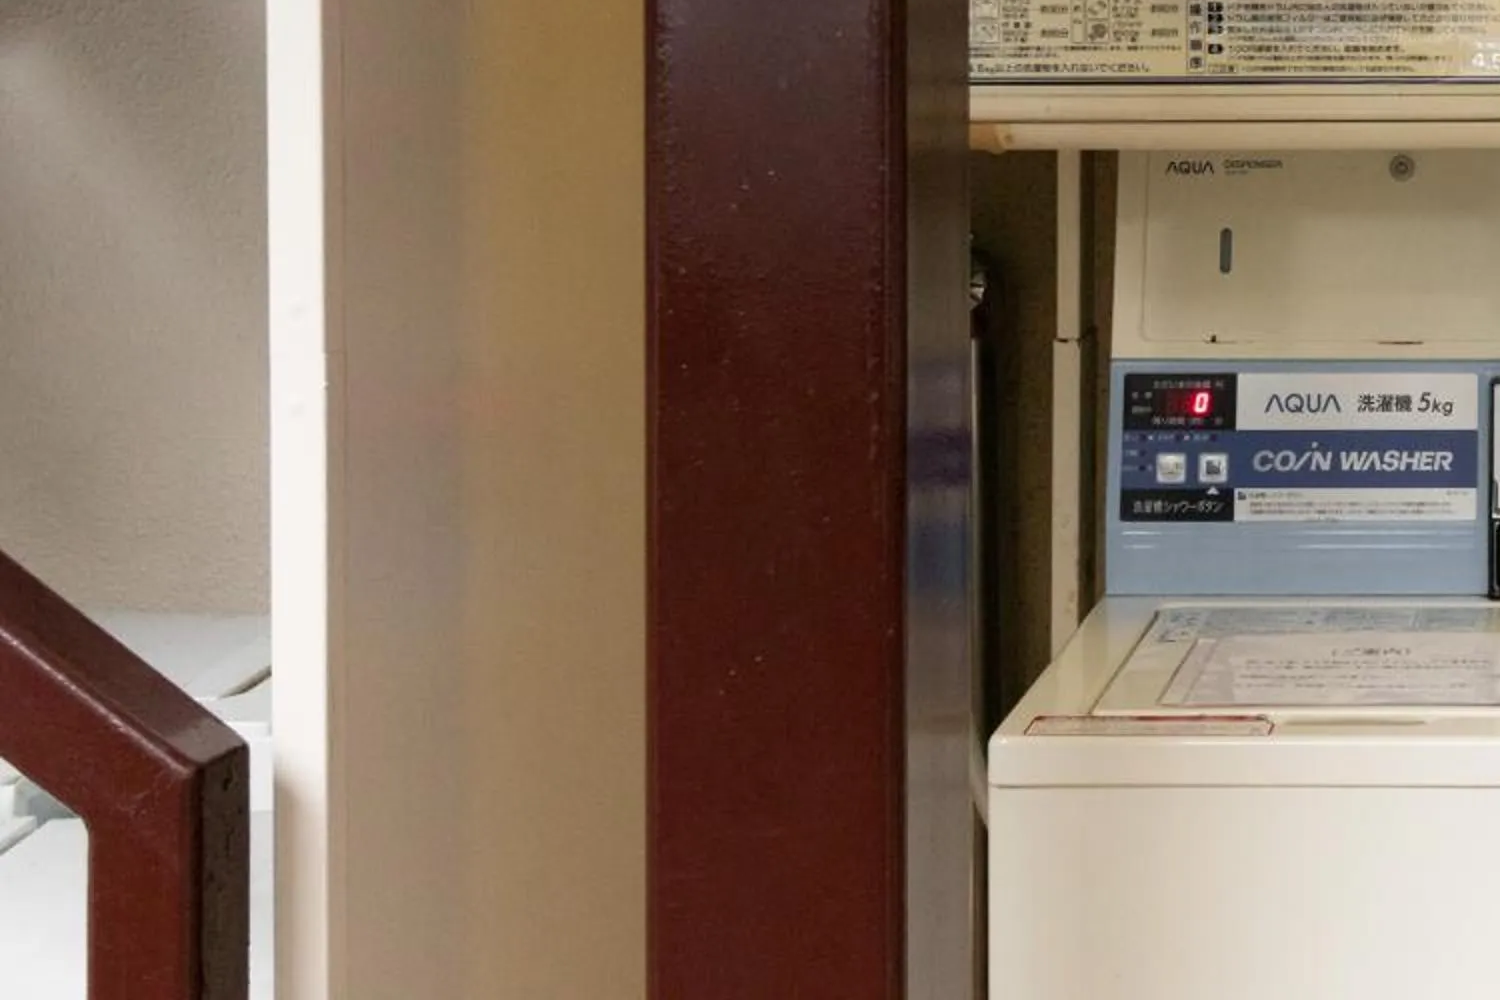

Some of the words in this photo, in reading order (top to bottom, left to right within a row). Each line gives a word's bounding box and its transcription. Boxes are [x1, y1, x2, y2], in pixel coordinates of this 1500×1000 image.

[1165, 160, 1214, 175] AQUA
[1194, 391, 1210, 413] 0
[1264, 393, 1341, 413] AQUA
[1357, 394, 1412, 412] 洗濯機
[1417, 392, 1454, 416] 5kg
[1340, 451, 1453, 472] WASHER
